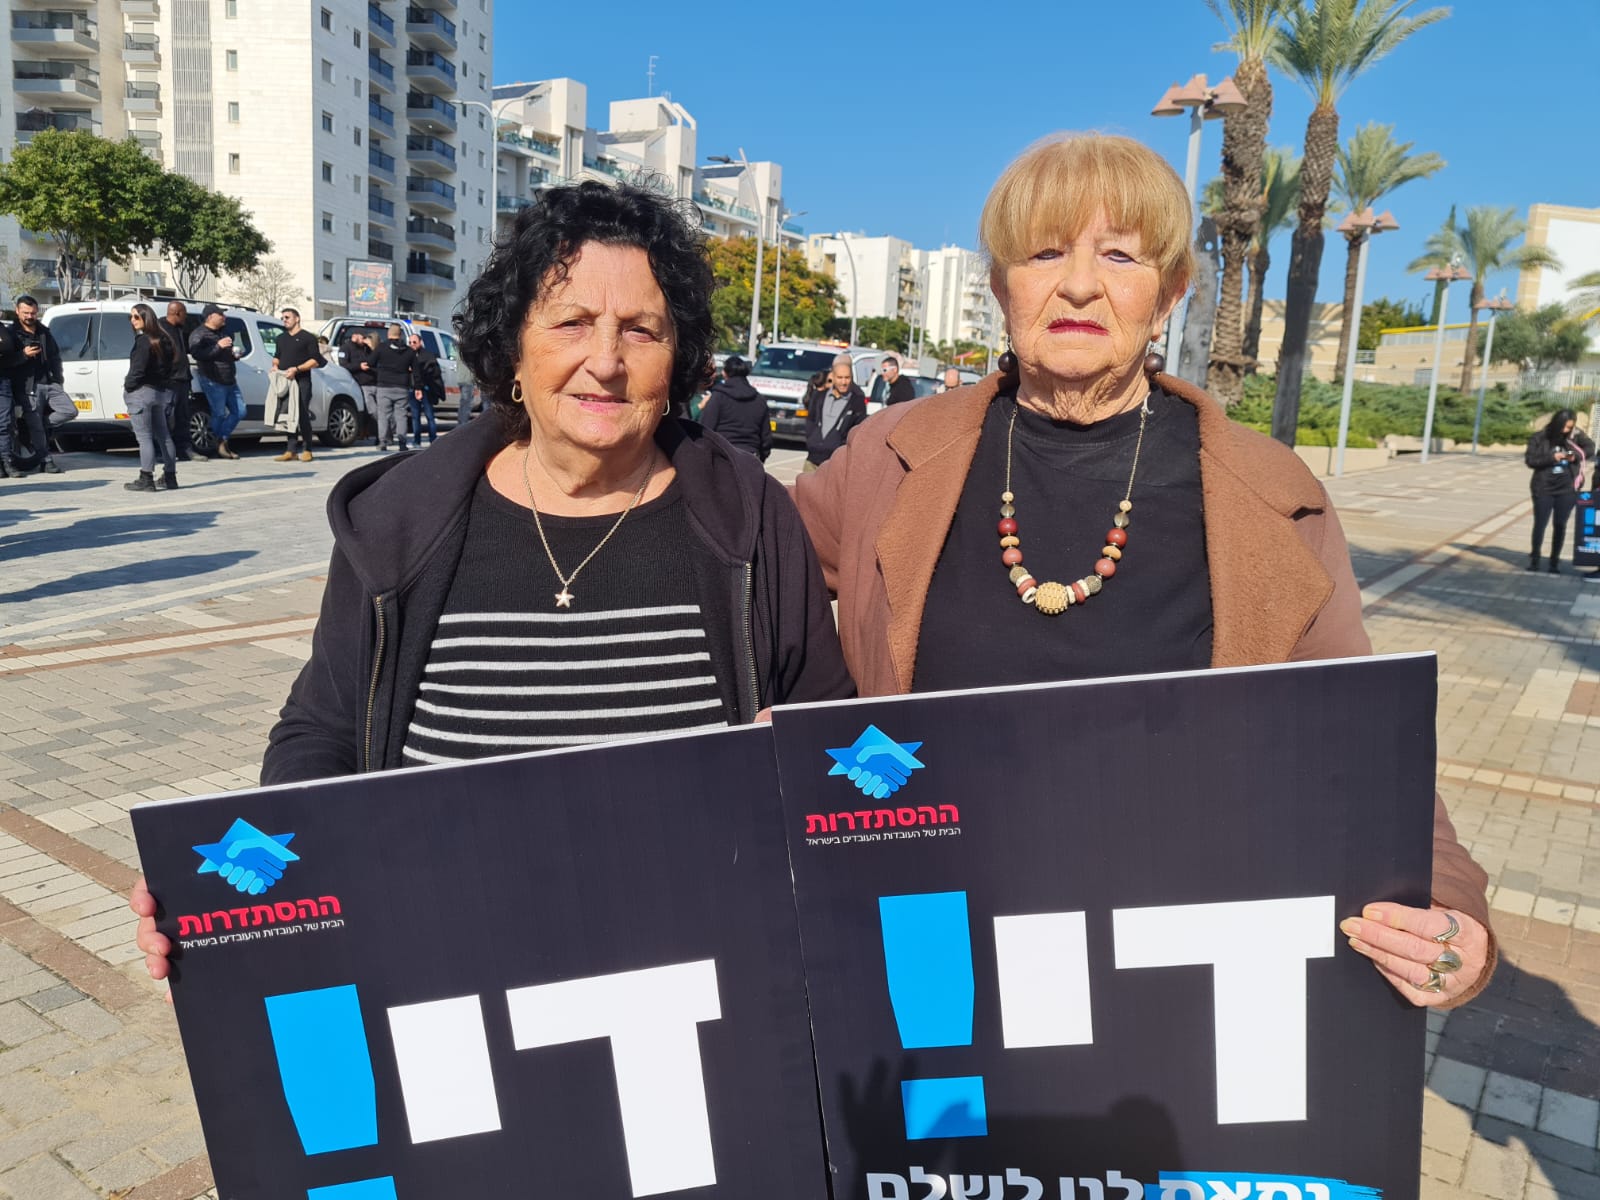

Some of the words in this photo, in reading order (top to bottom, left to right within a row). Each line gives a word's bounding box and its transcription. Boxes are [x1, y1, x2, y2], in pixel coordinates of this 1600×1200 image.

[806, 805, 959, 833] ההסתדרות
[882, 830, 921, 841] העובדות
[922, 829, 937, 838] של
[938, 827, 961, 836] הבית
[805, 836, 841, 846] בישראל
[842, 833, 881, 844] והעובדים
[177, 896, 341, 935] ההסתדרות
[304, 922, 319, 932] של
[320, 919, 345, 930] הבית
[262, 924, 303, 938] העובדות
[179, 936, 218, 949] בישראל
[219, 931, 261, 944] והעובדים
